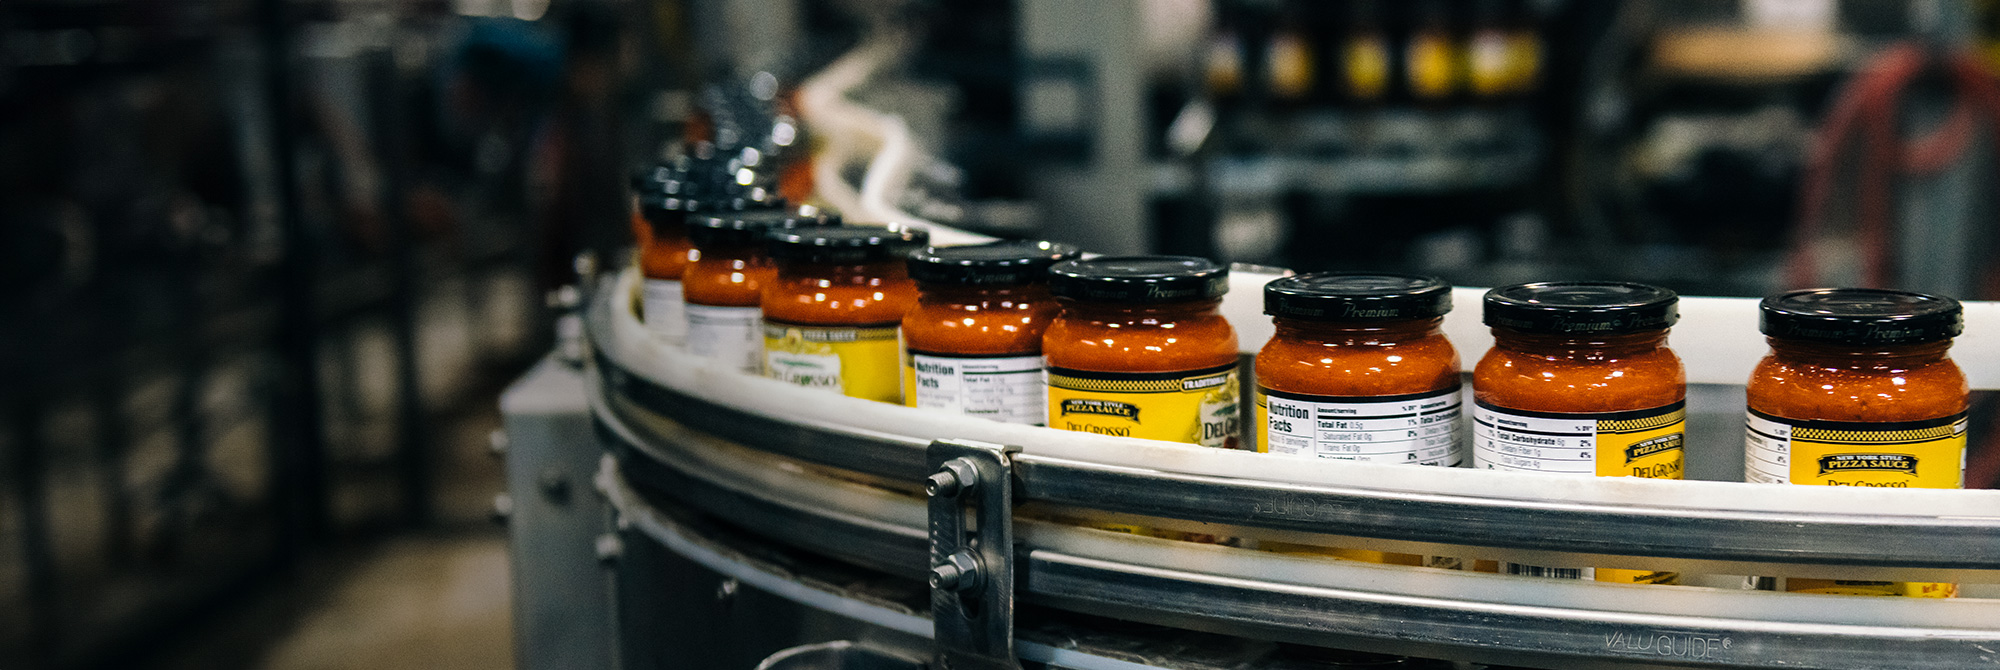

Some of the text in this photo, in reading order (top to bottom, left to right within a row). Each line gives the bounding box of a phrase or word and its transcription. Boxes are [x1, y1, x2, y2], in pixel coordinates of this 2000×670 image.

[1146, 284, 1197, 298] Premium
[1343, 301, 1399, 317] Premium
[1551, 314, 1613, 332] Premium
[1863, 322, 1925, 339] Premium
[917, 362, 954, 375] Nutrition
[917, 375, 939, 389] Facts
[1066, 404, 1130, 416] PIZZA SAUCE
[1269, 401, 1309, 420] Nutrition
[1269, 416, 1292, 433] Facts
[1317, 421, 1334, 429] Total
[1336, 421, 1347, 429] Fat
[1323, 432, 1351, 440] Saturated
[1512, 433, 1555, 446] Carbohydrate
[1323, 444, 1340, 452] Trans
[1342, 444, 1352, 452] Fat
[1828, 460, 1910, 469] PIZZA SAUCE
[1605, 631, 1654, 651] VALU
